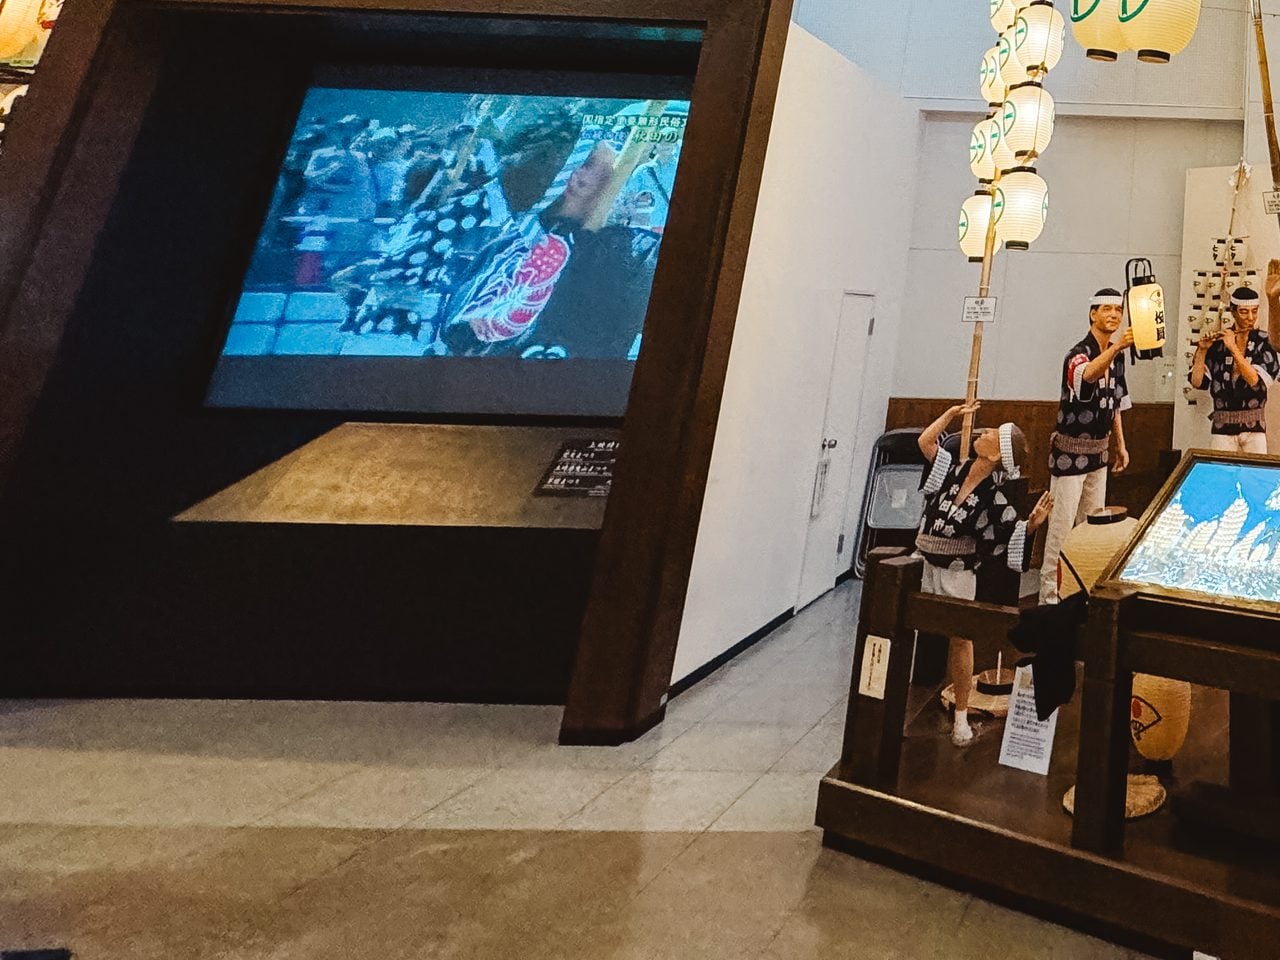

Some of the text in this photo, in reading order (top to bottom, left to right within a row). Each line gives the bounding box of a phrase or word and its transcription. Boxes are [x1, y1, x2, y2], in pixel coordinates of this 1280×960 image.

[1155, 310, 1165, 341] 役員
[933, 484, 960, 531] 秋田市
